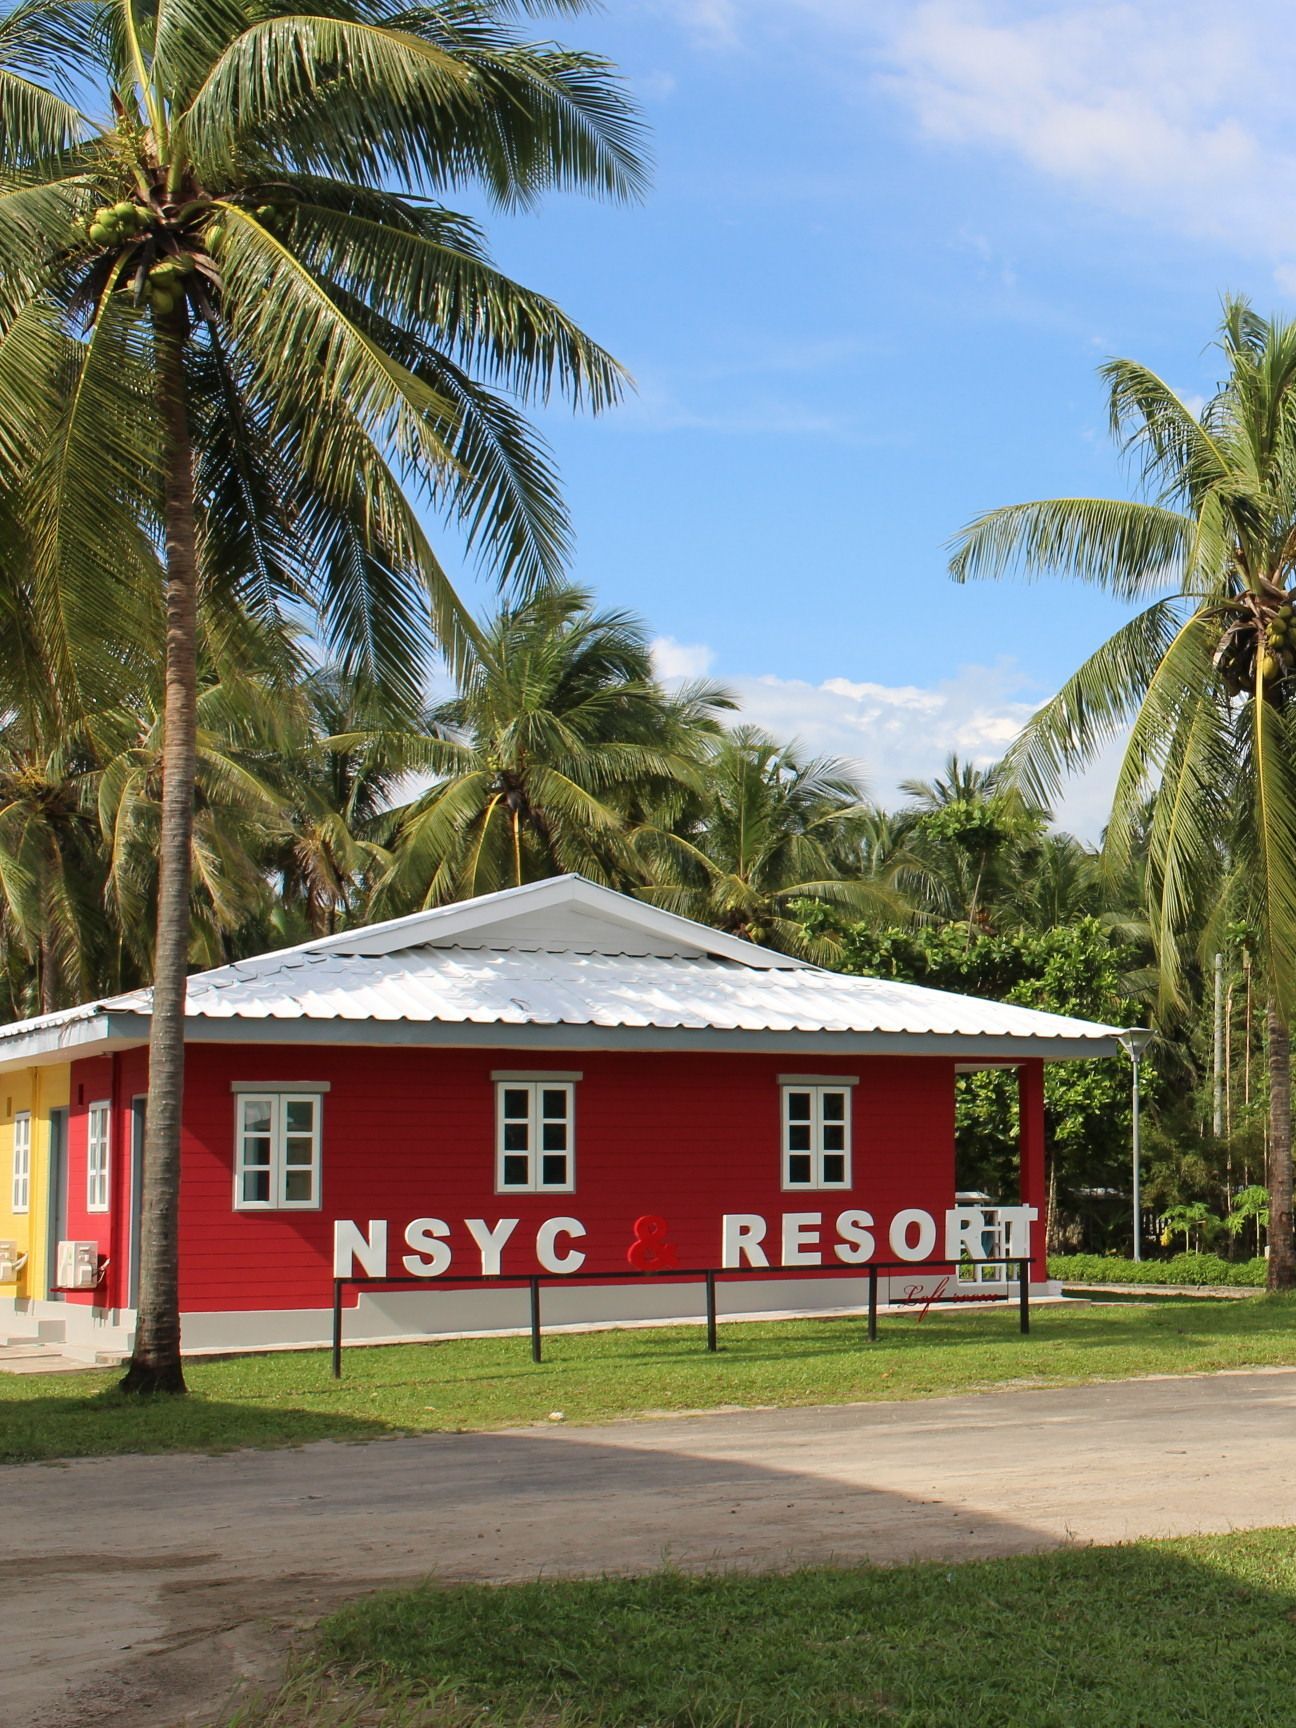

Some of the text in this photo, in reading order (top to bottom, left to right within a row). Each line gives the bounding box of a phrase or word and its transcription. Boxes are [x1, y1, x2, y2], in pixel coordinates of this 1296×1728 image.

[334, 1208, 1038, 1278] NSYC & RESORT
